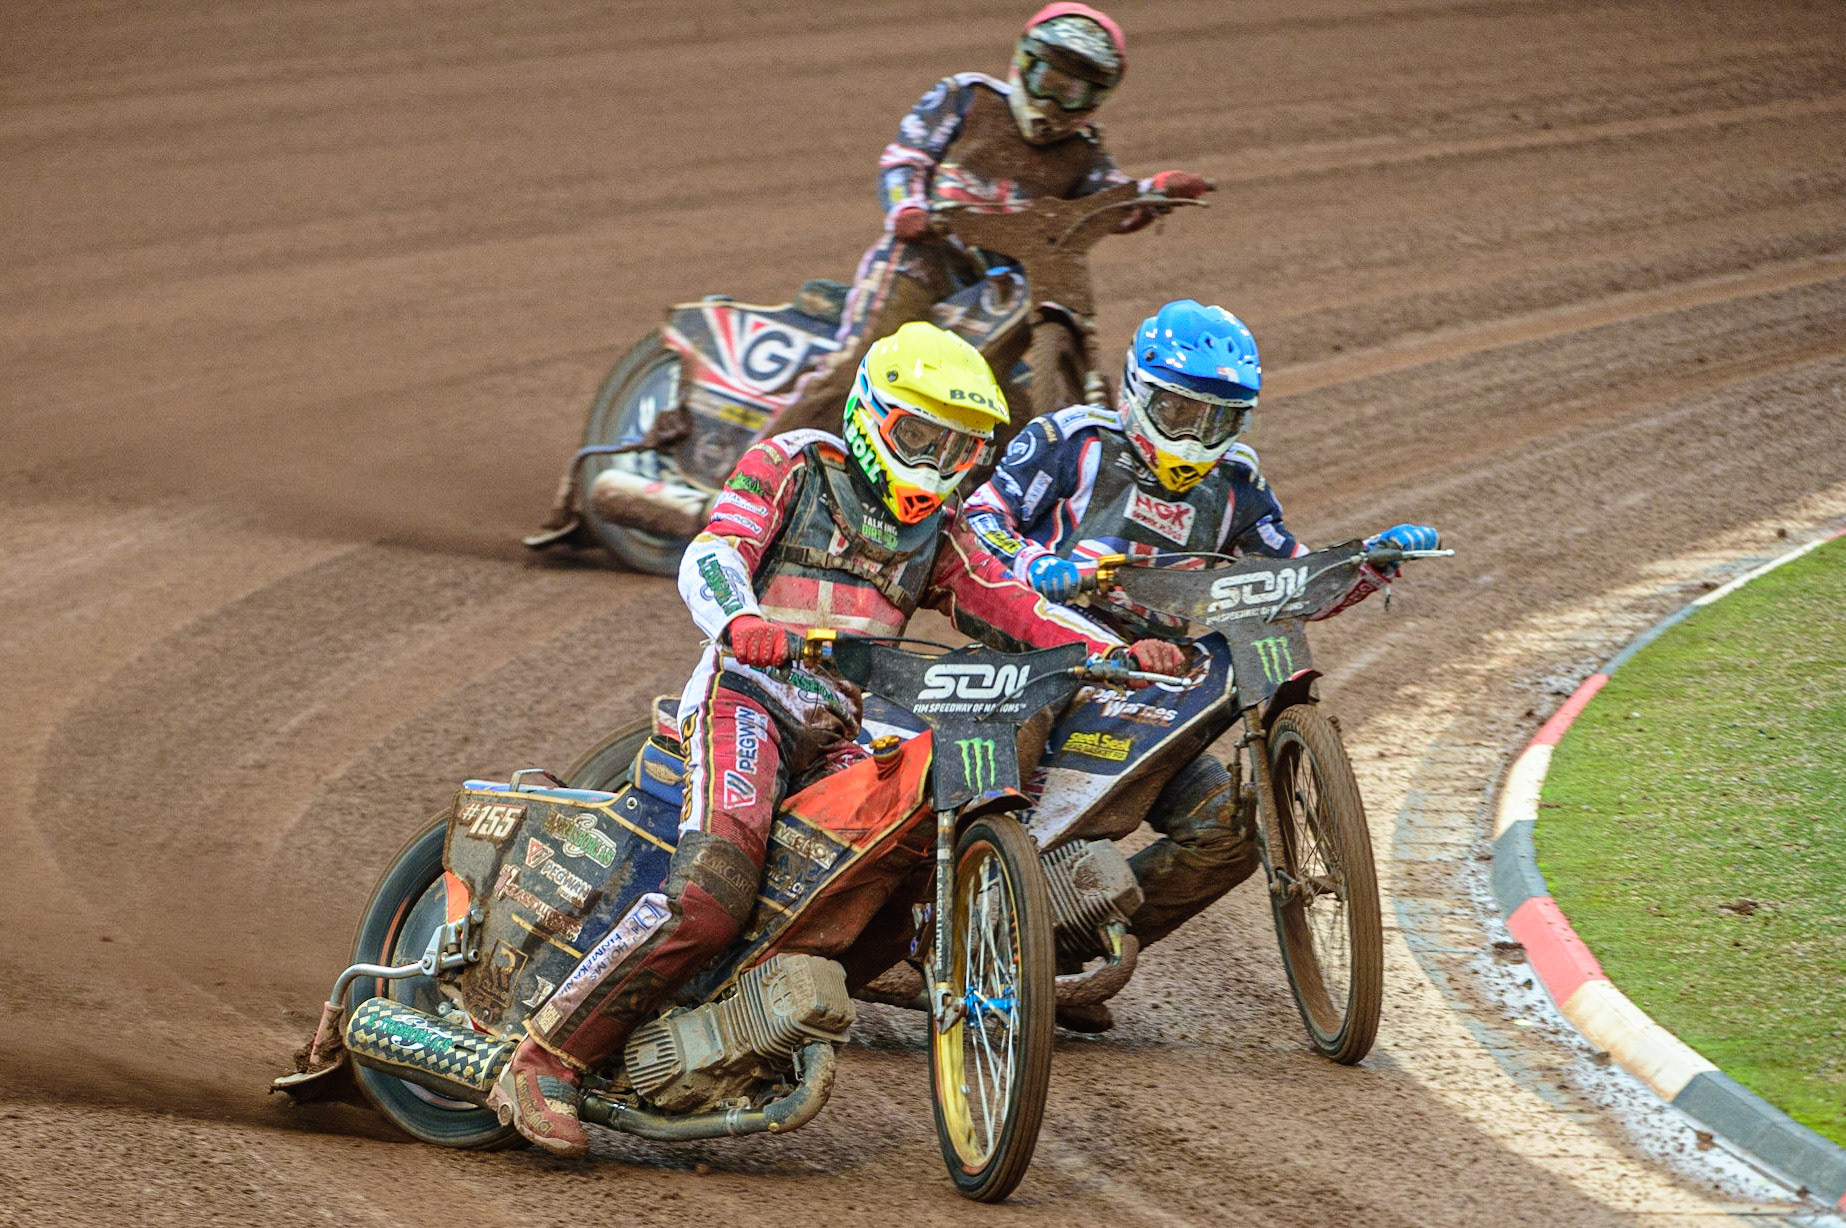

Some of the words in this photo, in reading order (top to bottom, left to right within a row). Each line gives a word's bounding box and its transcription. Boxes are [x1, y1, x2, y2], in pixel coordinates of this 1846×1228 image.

[743, 331, 793, 381] G
[913, 703, 929, 713] FIM
[929, 703, 972, 713] SPEEDWAY
[972, 703, 984, 713] OF
[462, 803, 523, 838] #155
